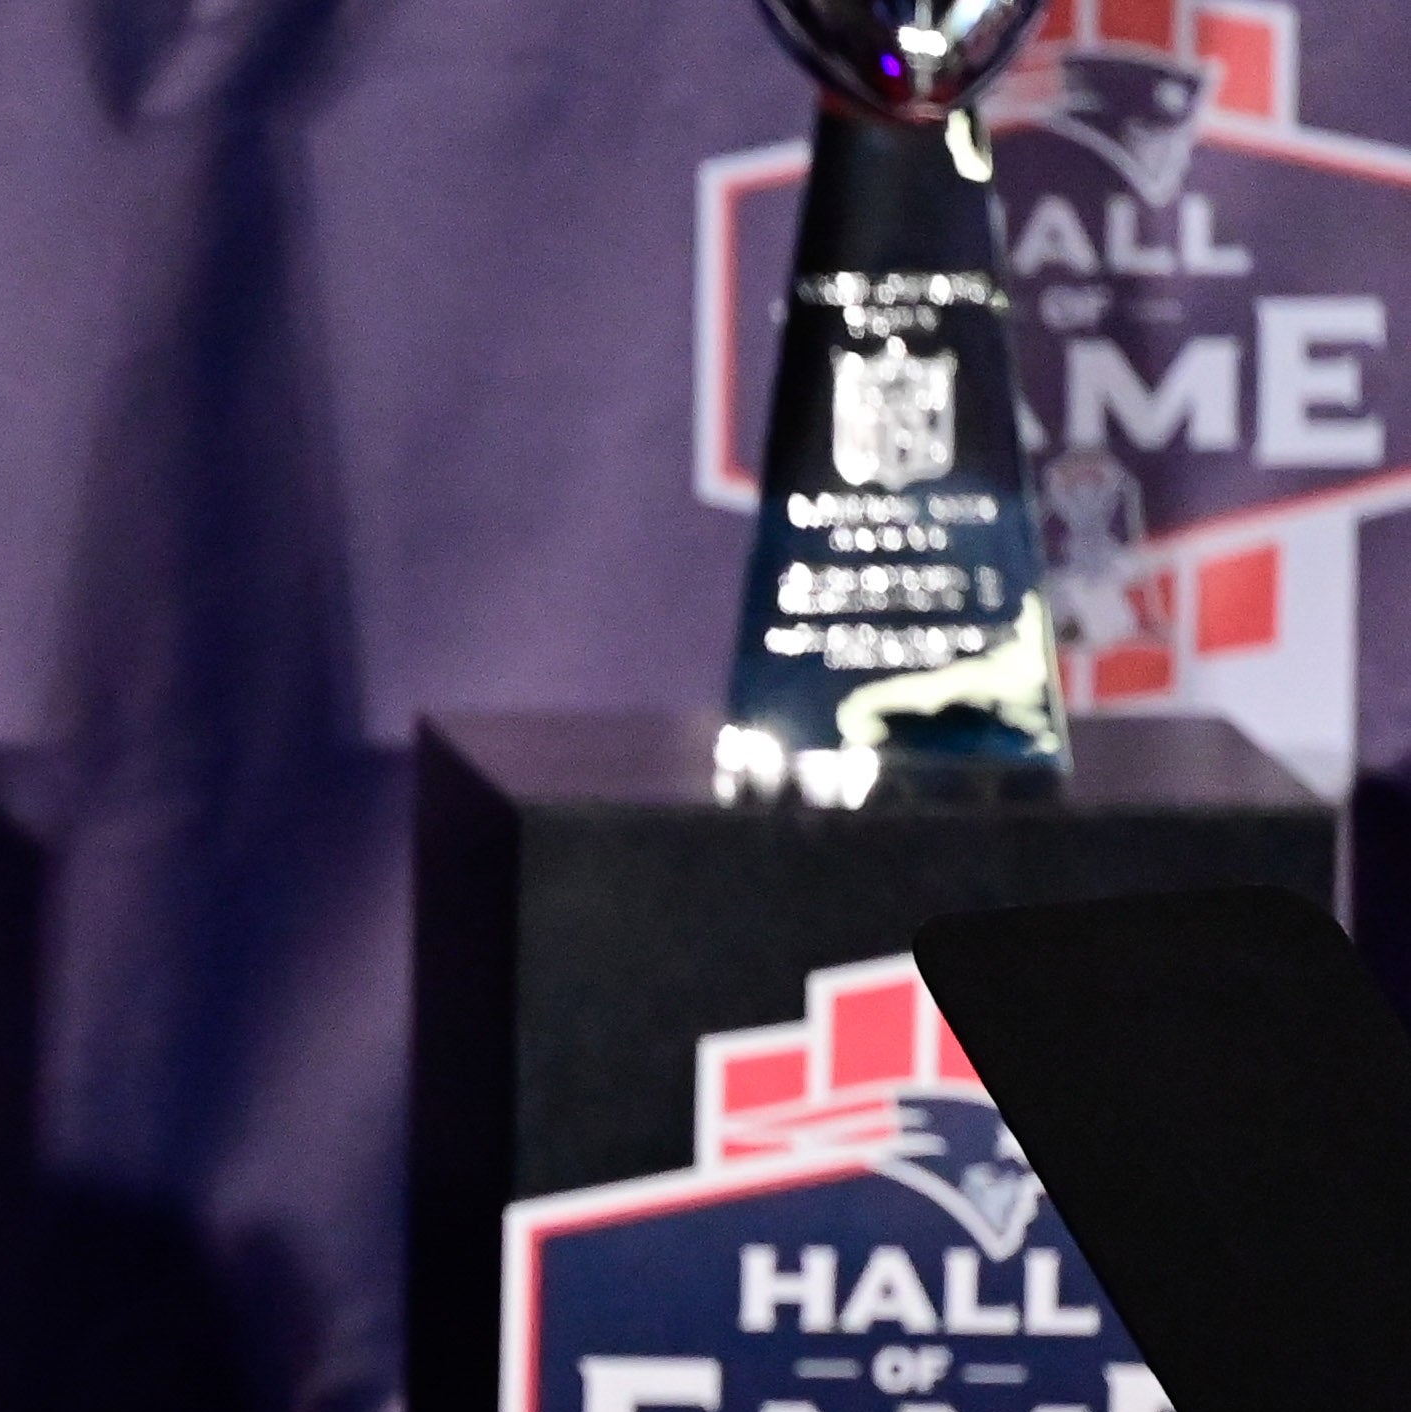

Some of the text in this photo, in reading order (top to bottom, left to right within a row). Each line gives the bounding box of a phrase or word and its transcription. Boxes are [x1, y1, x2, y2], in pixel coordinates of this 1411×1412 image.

[1011, 195, 1253, 278] ALL
[1015, 294, 1389, 471] ME
[737, 1241, 1101, 1337] HALL
[871, 1343, 953, 1396] OF
